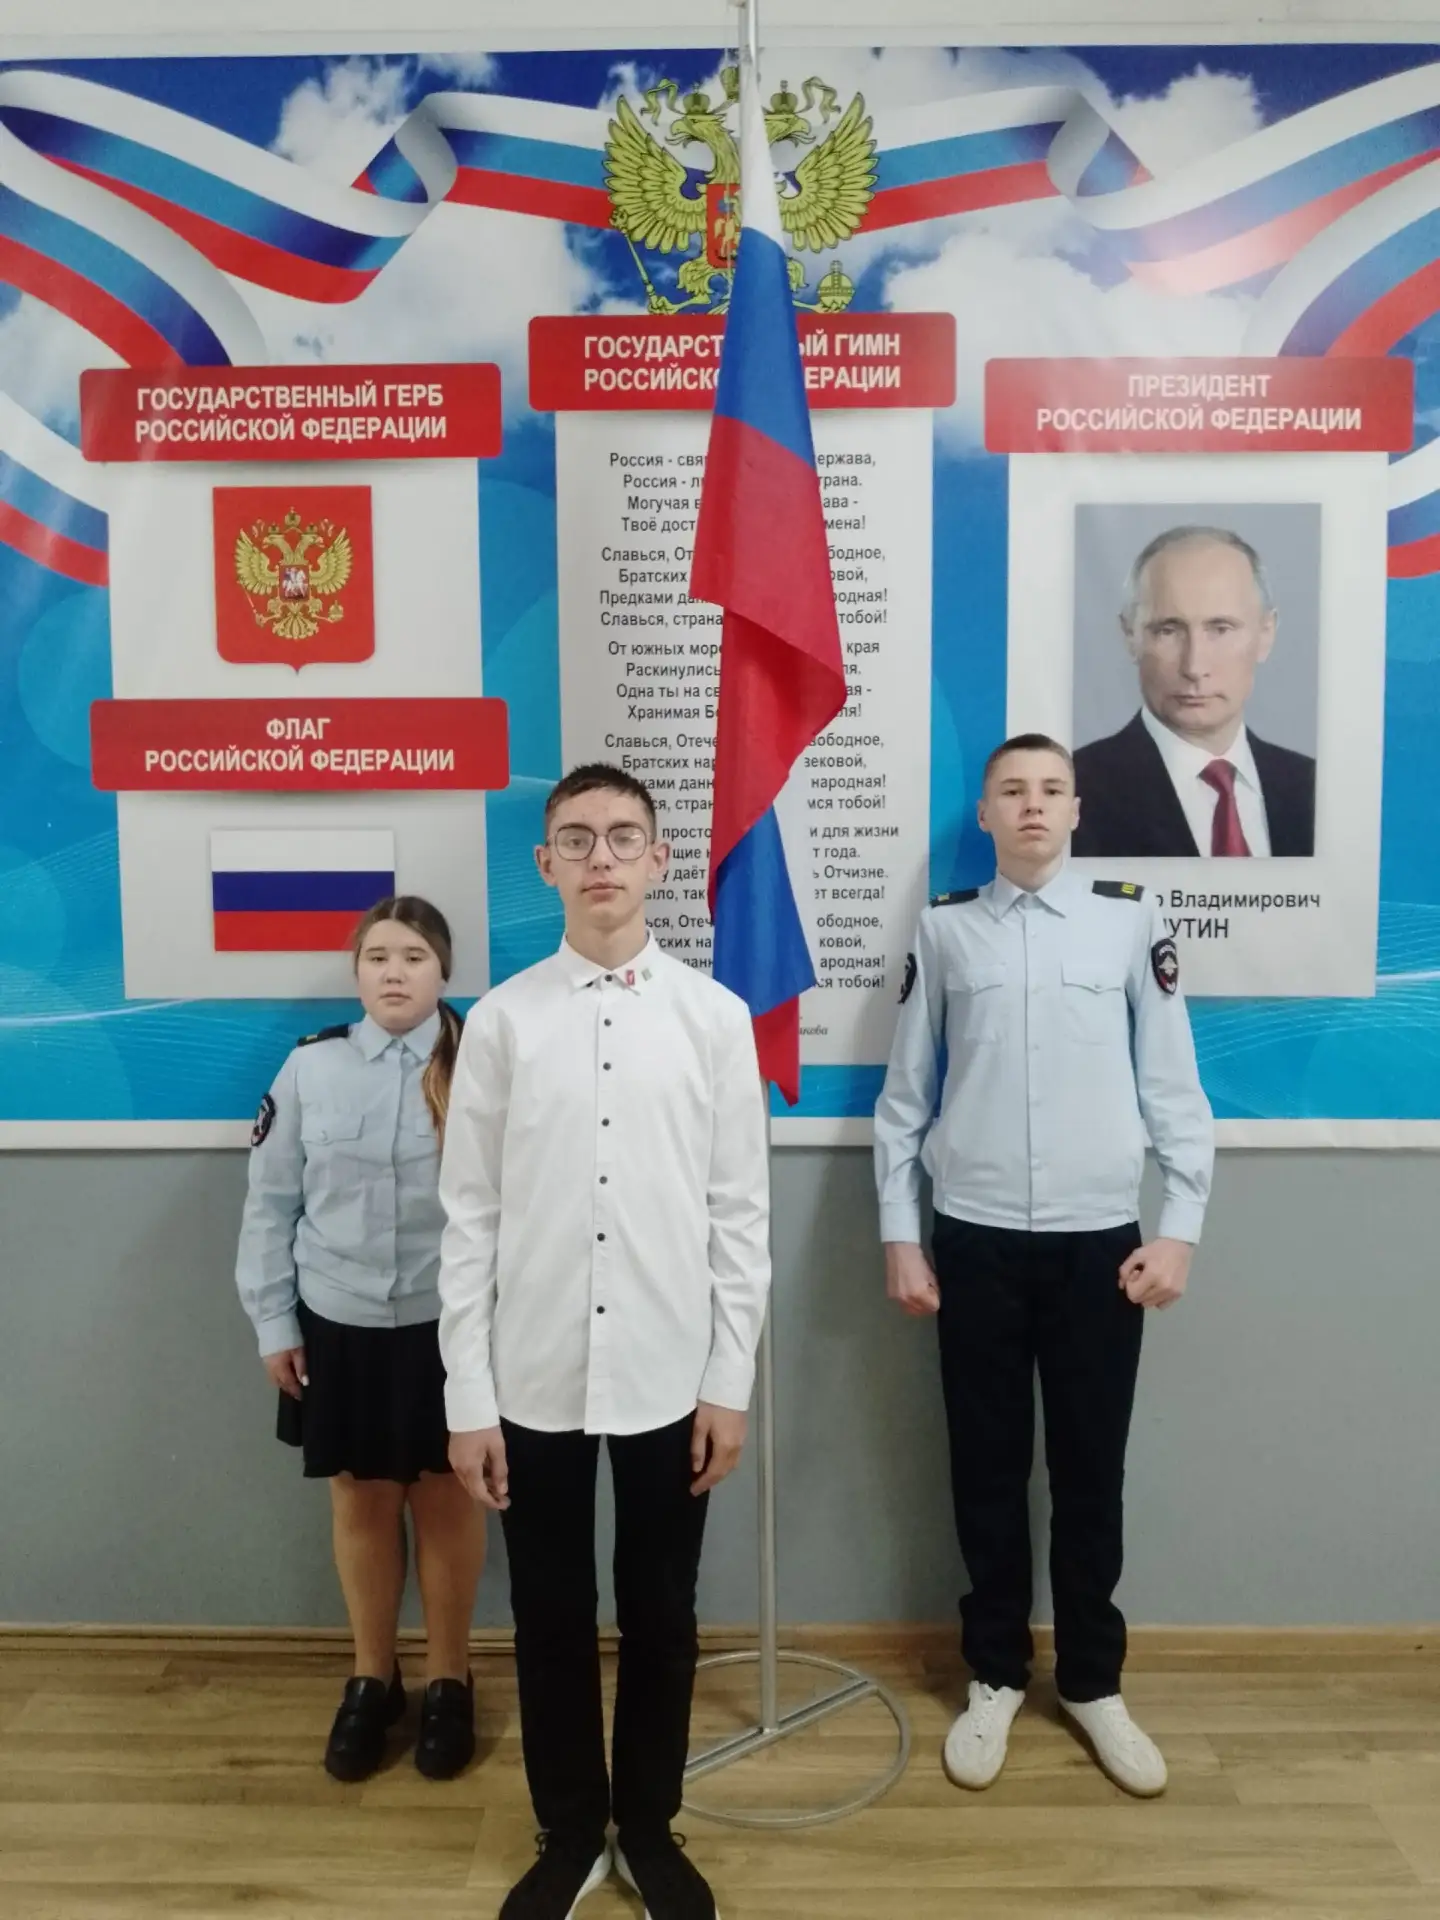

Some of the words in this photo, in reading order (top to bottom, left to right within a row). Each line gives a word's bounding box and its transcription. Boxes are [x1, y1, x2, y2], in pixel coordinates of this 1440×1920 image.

[835, 333, 900, 357] ГИМН
[584, 363, 720, 391] РОССИЙСК
[804, 366, 901, 393] ЕРАЦИИ
[1128, 374, 1272, 401] ПРЕЗИДЕНТ
[137, 380, 377, 413] ГОСУДАРСТВЕННЫЙ
[384, 384, 444, 407] ГЕРБ
[1037, 403, 1204, 431] РОССИЙСКОЙ
[1210, 407, 1362, 434] ФЕДЕРАЦИИ
[135, 413, 295, 443] РОССИЙСКОЙ
[301, 416, 447, 443] ФЕДЕРАЦИИ
[609, 452, 664, 467] Россия
[817, 453, 876, 468] ержава,
[623, 474, 677, 488] Россия
[627, 496, 690, 513] Могучая
[621, 516, 657, 531] Твоё
[824, 515, 866, 530] мена!
[601, 546, 670, 563] Славься,
[827, 545, 885, 562] бодное,
[618, 568, 688, 586] Братских
[830, 566, 868, 583] овой,
[600, 590, 673, 607] Предками
[601, 611, 669, 628] Славься,
[673, 614, 723, 629] страна
[838, 609, 888, 624] тобой!
[608, 640, 627, 655] От
[632, 644, 685, 655] южных
[846, 642, 880, 656] края
[616, 683, 654, 700] Одна
[658, 686, 679, 698] ты
[684, 686, 700, 698] на
[628, 704, 700, 722] Хранимая
[266, 718, 331, 740] ФЛАГ
[605, 734, 672, 750] Славься,
[676, 734, 718, 748] Отече
[145, 744, 304, 772] РОССИЙСКОЙ
[310, 749, 455, 775] ФЕДЕРАЦИИ
[622, 755, 690, 771] Братских
[679, 778, 715, 791] данн
[811, 773, 887, 791] народная!
[675, 799, 715, 813] стран
[837, 795, 886, 810] тобой!
[662, 827, 712, 842] просто
[822, 826, 850, 840] для
[854, 825, 900, 838] жизни
[824, 846, 861, 860] года.
[673, 864, 706, 881] даёт
[824, 864, 889, 879] Отчизне.
[683, 888, 706, 900] так
[831, 886, 886, 901] всегда!
[1171, 890, 1320, 912] Владимирович
[816, 913, 883, 929] ободное,
[1163, 918, 1229, 939] УТИН
[819, 934, 866, 949] ковой,
[820, 955, 886, 971] ародная!
[838, 973, 886, 988] тобой!
